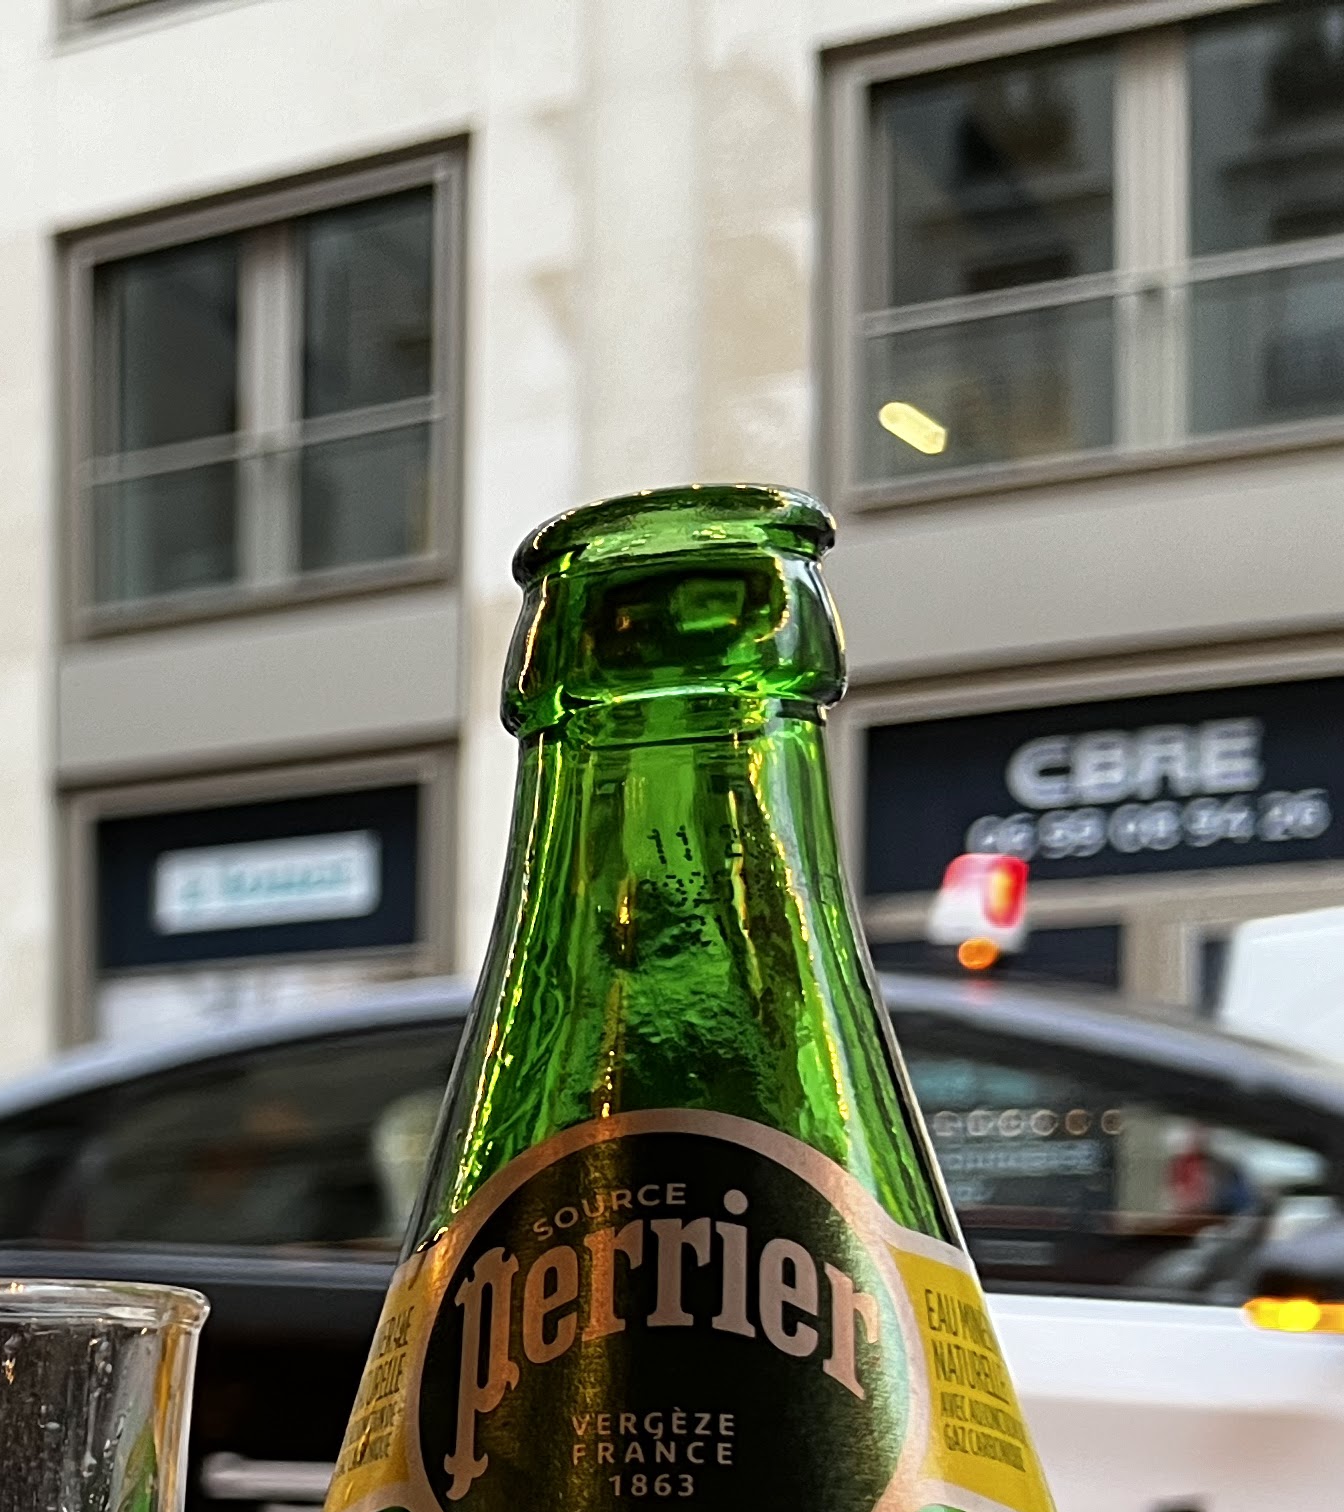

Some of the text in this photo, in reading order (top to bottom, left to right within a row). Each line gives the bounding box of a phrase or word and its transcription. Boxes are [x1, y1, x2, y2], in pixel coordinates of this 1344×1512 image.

[1007, 718, 1263, 807] CBRE
[533, 1183, 687, 1241] SOURCE
[924, 1288, 959, 1337] EAU
[444, 1189, 879, 1500] perrier
[571, 1406, 735, 1440] VERGÈZE
[572, 1441, 734, 1465] FRANCE
[608, 1473, 695, 1497] 1863
